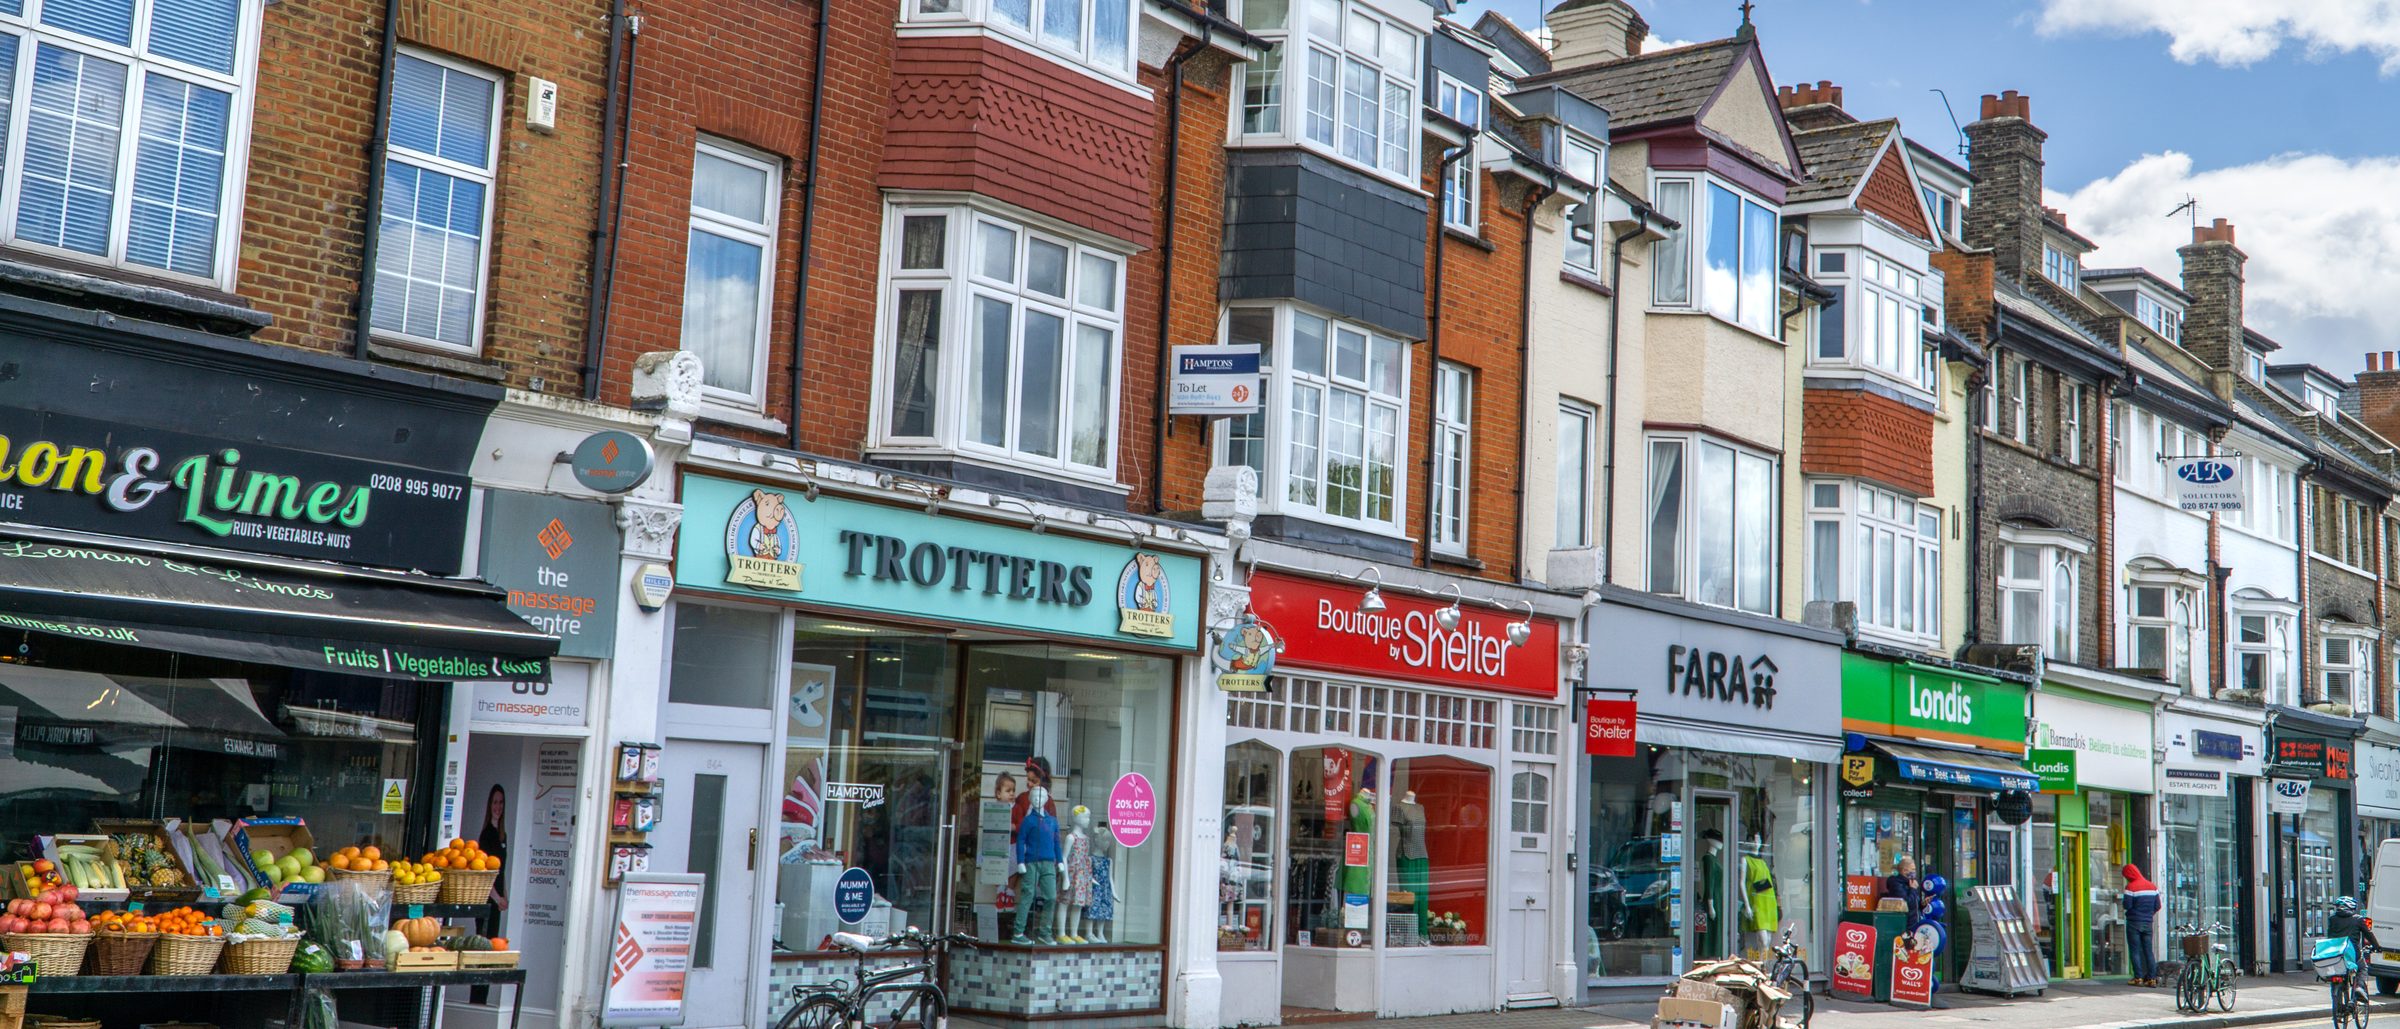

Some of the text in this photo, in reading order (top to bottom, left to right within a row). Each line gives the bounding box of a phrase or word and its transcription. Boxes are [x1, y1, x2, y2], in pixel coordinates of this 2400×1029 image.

[1184, 358, 1233, 370] HAMPTONS
[1177, 383, 1207, 393] To Let
[108, 447, 171, 512] &
[172, 449, 371, 537] Limes
[370, 473, 463, 501] 0208 995 9077
[2181, 502, 2197, 510] 020
[232, 521, 351, 549] RUITS-VEGETABLES-NUTS
[0, 541, 151, 567] Lemon
[737, 558, 798, 576] TROTTERS
[839, 529, 1093, 607] TROTTERS
[537, 566, 568, 588] the
[507, 588, 596, 618] massage
[1126, 611, 1170, 624] TROTTERS
[1318, 598, 1401, 645] Boutique
[1389, 610, 1512, 677] by Shelter
[324, 646, 379, 669] Fruits
[394, 651, 488, 678] Vegetables
[1667, 643, 1749, 705] FARA
[1220, 679, 1261, 687] TROTTERS
[1909, 674, 1972, 725] Londis
[1590, 715, 1626, 726] Boutique by
[1590, 723, 1633, 739] Shelter
[2049, 728, 2086, 750] Barnardo's
[1910, 764, 1927, 778] Wine
[1955, 771, 1972, 784] News
[2033, 762, 2070, 773] Londis
[827, 785, 882, 800] HAMPTON
[1115, 799, 1150, 809] 20% OFF
[1111, 818, 1122, 826] BUY
[532, 848, 569, 858] THE TRUSTE
[530, 858, 563, 867] PLACE FOR
[530, 867, 560, 876] MASSAGE
[529, 876, 558, 885] CHISWICK
[840, 881, 869, 889] MUMMY
[1859, 882, 1871, 895] and
[844, 892, 863, 901] & ME
[1850, 896, 1867, 909] shine
[1846, 942, 1865, 950] WALL'S
